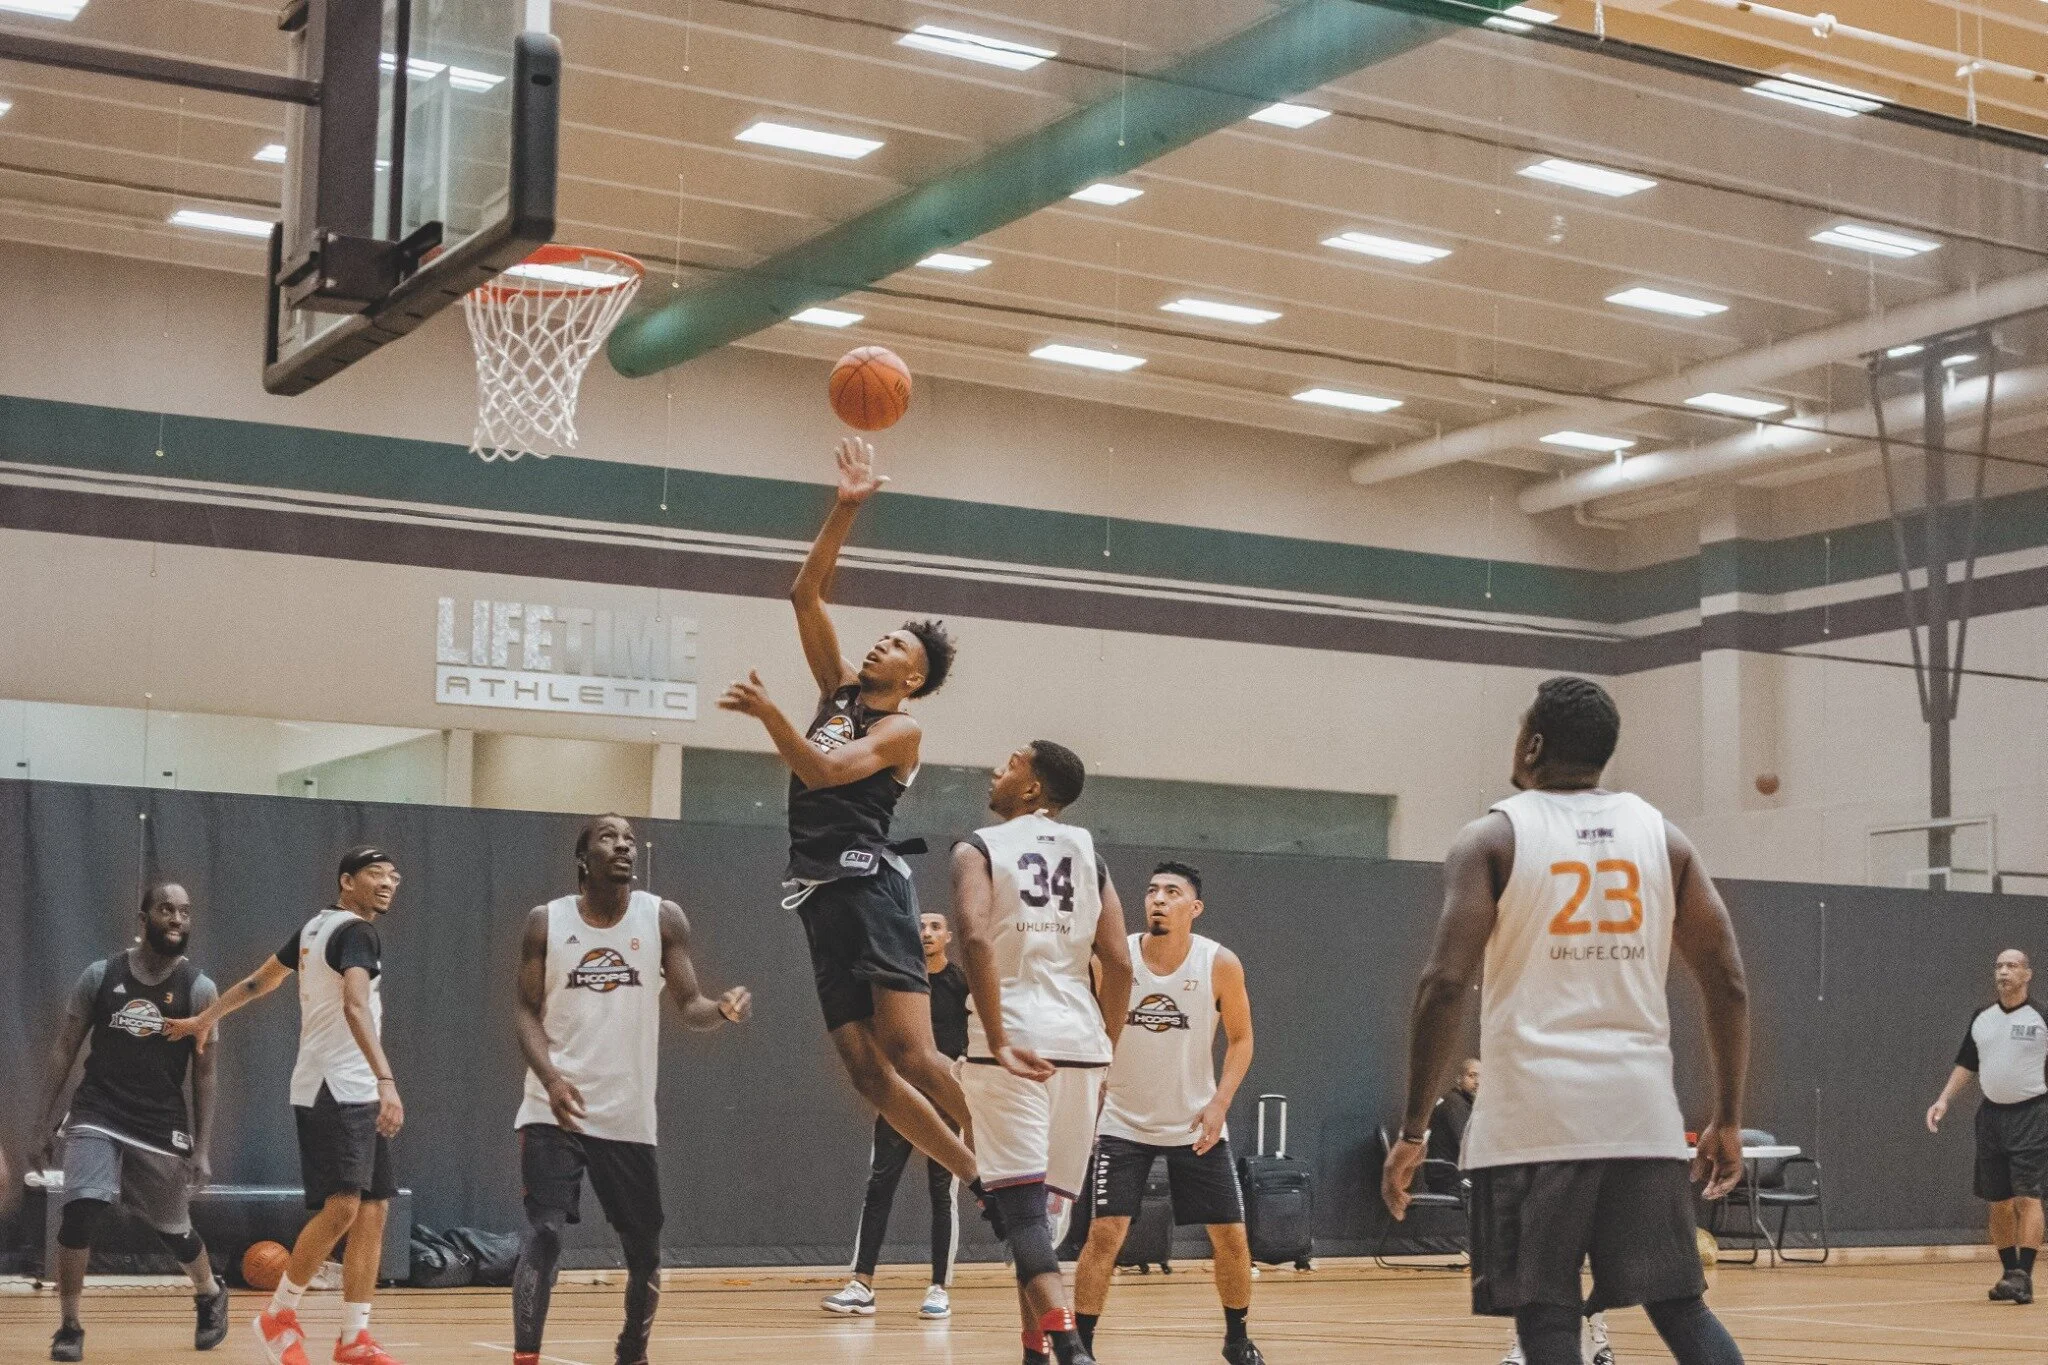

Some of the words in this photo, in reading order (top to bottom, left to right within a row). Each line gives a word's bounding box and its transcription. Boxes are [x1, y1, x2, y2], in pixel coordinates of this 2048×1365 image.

[445, 675, 689, 711] ATHLETIC
[1016, 852, 1075, 912] 34
[1548, 859, 1643, 936] 23
[631, 938, 640, 951] 8
[1549, 945, 1645, 961] UHLIFE.COM
[577, 972, 630, 984] HOOPS
[1183, 979, 1199, 992] 27
[165, 992, 174, 1004] 3
[119, 1017, 162, 1030] HOOPS
[1134, 1015, 1181, 1025] HOOPS
